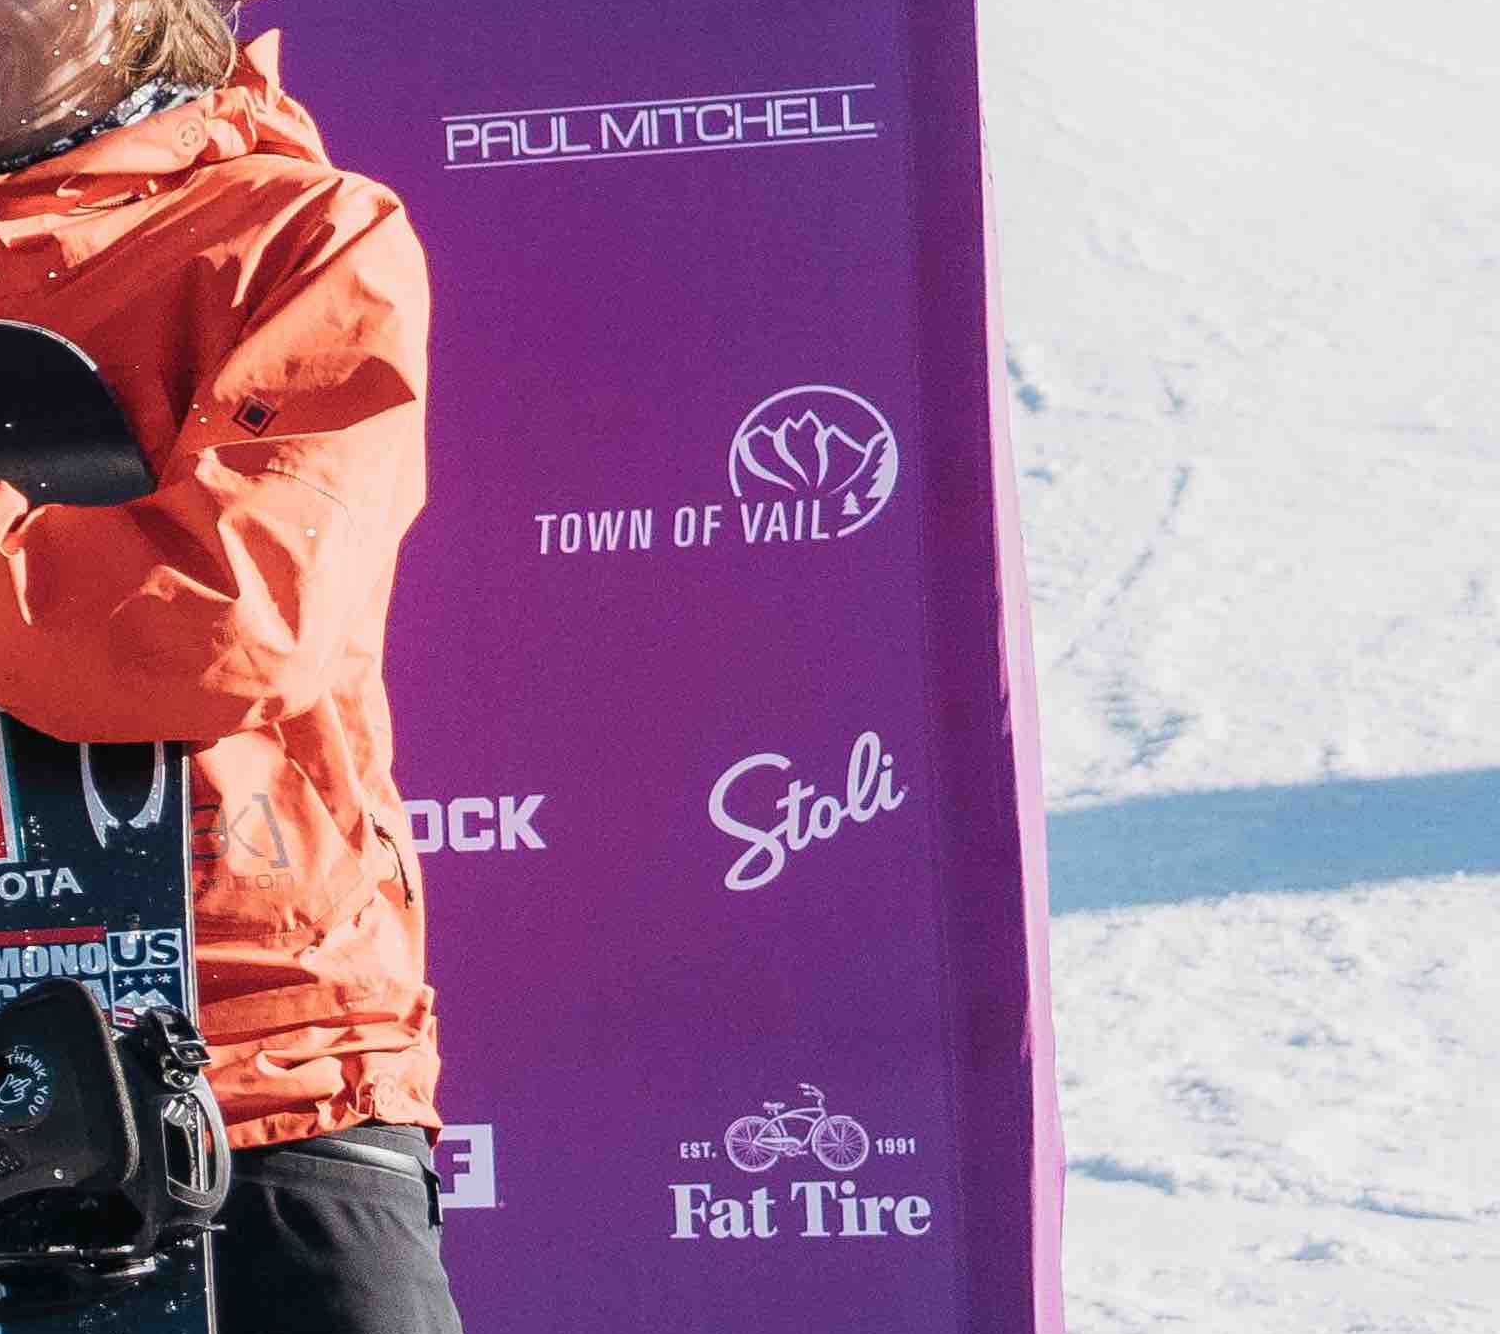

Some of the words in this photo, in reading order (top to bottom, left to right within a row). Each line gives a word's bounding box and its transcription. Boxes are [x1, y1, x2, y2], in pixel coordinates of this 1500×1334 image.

[444, 117, 592, 164] PAUL
[602, 94, 877, 150] MITCHELL
[534, 508, 653, 555] TOWN
[673, 504, 723, 548] OF
[740, 499, 830, 544] VAIL
[708, 730, 905, 891] Stoli
[109, 932, 180, 967] US
[4, 1051, 47, 1081] THANK
[28, 1085, 49, 1116] YOU
[678, 1139, 719, 1160] EST.
[874, 1136, 918, 1157] 1991
[667, 1183, 778, 1239] Fat
[790, 1181, 931, 1237] Tire
